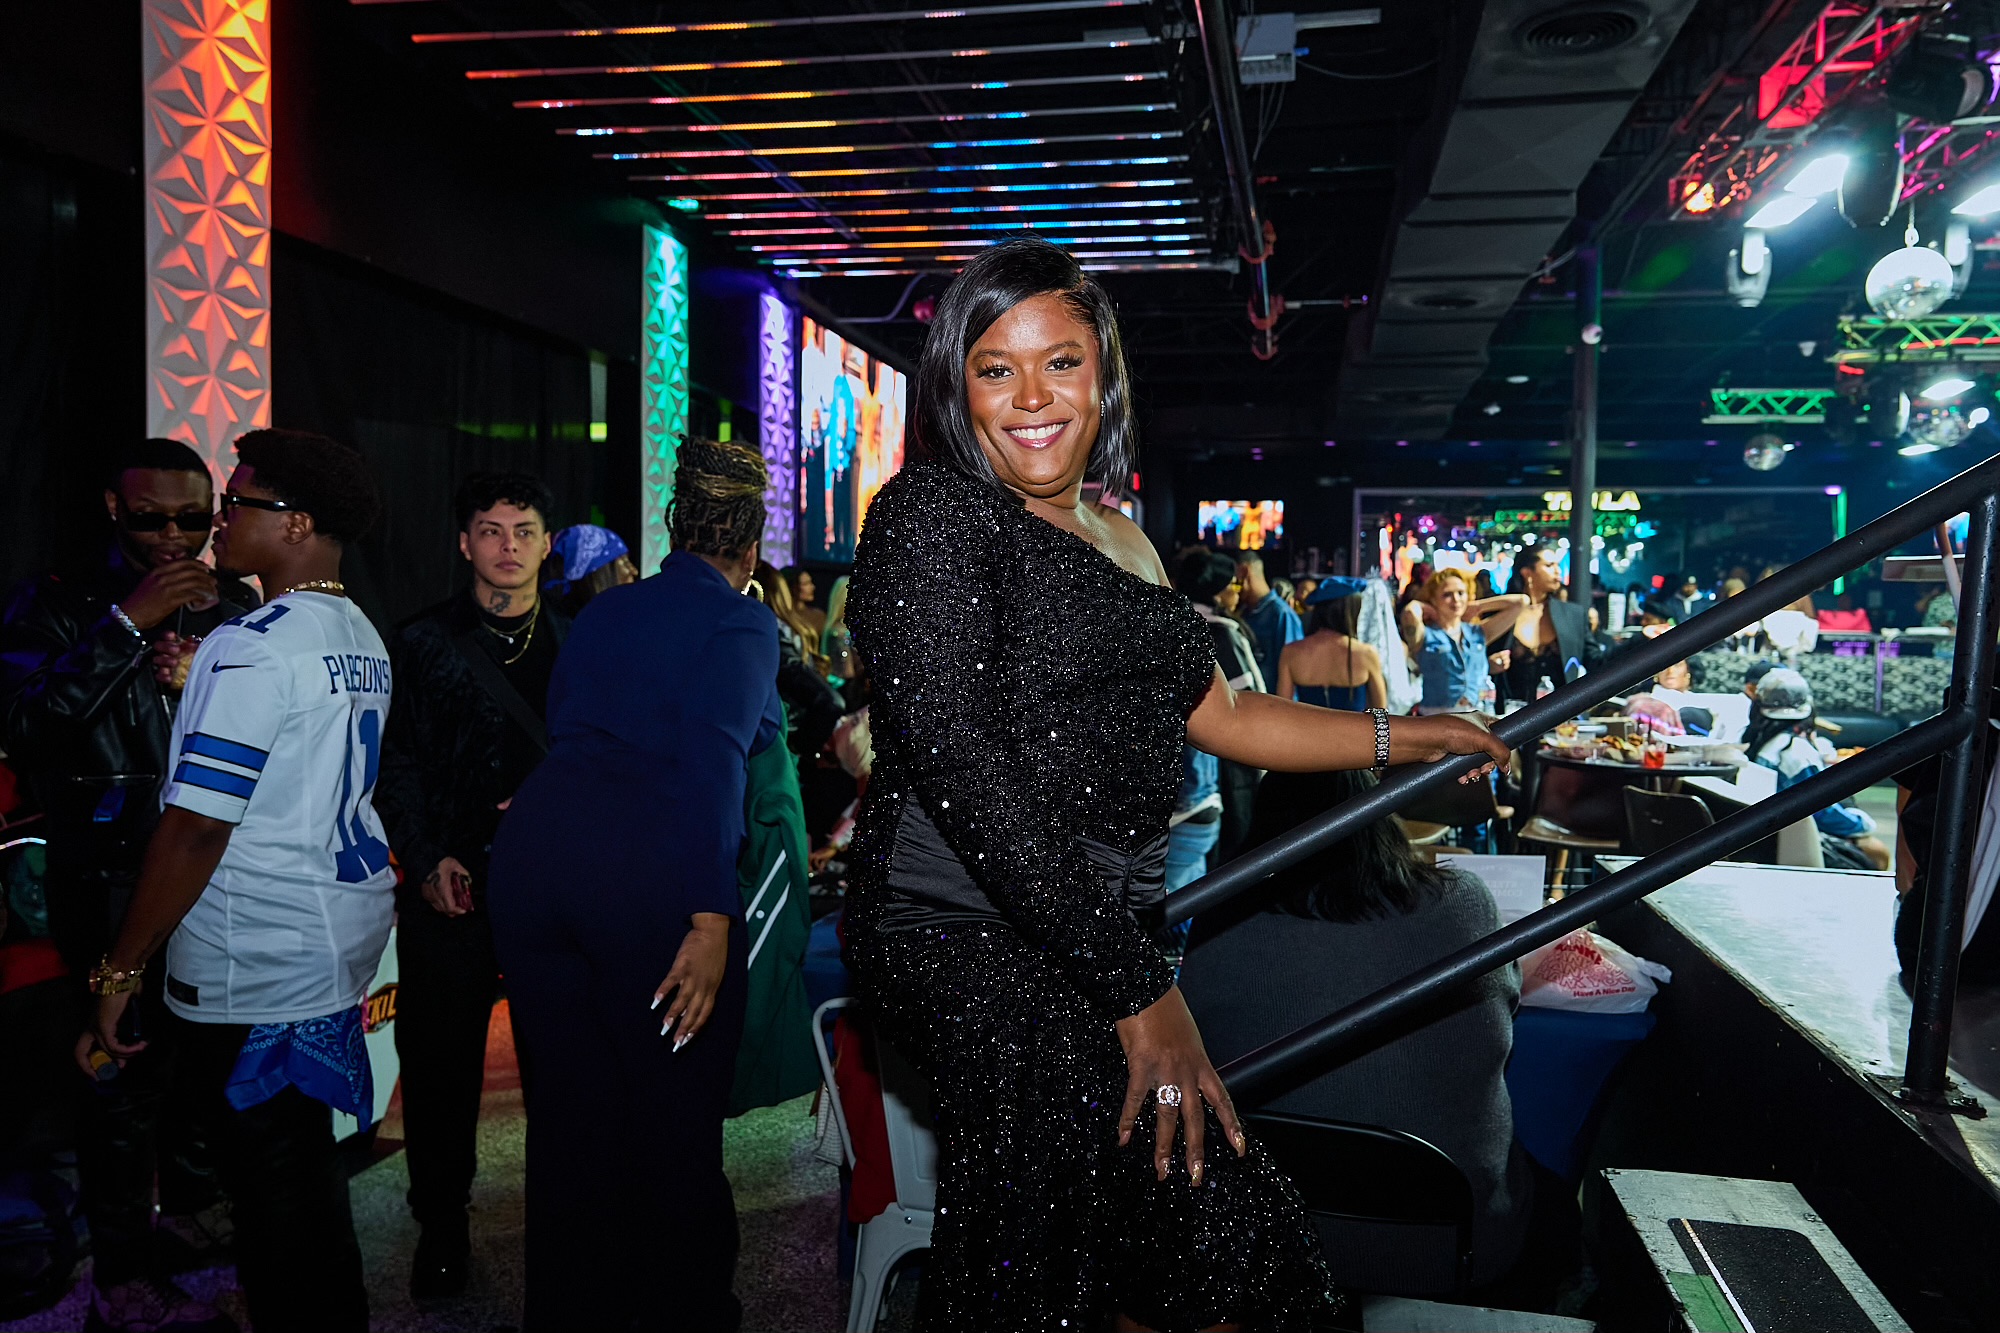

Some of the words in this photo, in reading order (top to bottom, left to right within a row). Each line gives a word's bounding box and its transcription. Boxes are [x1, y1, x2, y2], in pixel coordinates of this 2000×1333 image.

[222, 604, 291, 634] 1
[335, 709, 390, 884] 11
[1573, 988, 1595, 997] Have
[1595, 988, 1602, 996] A
[1602, 987, 1620, 996] Nice
[1621, 985, 1636, 995] Day
